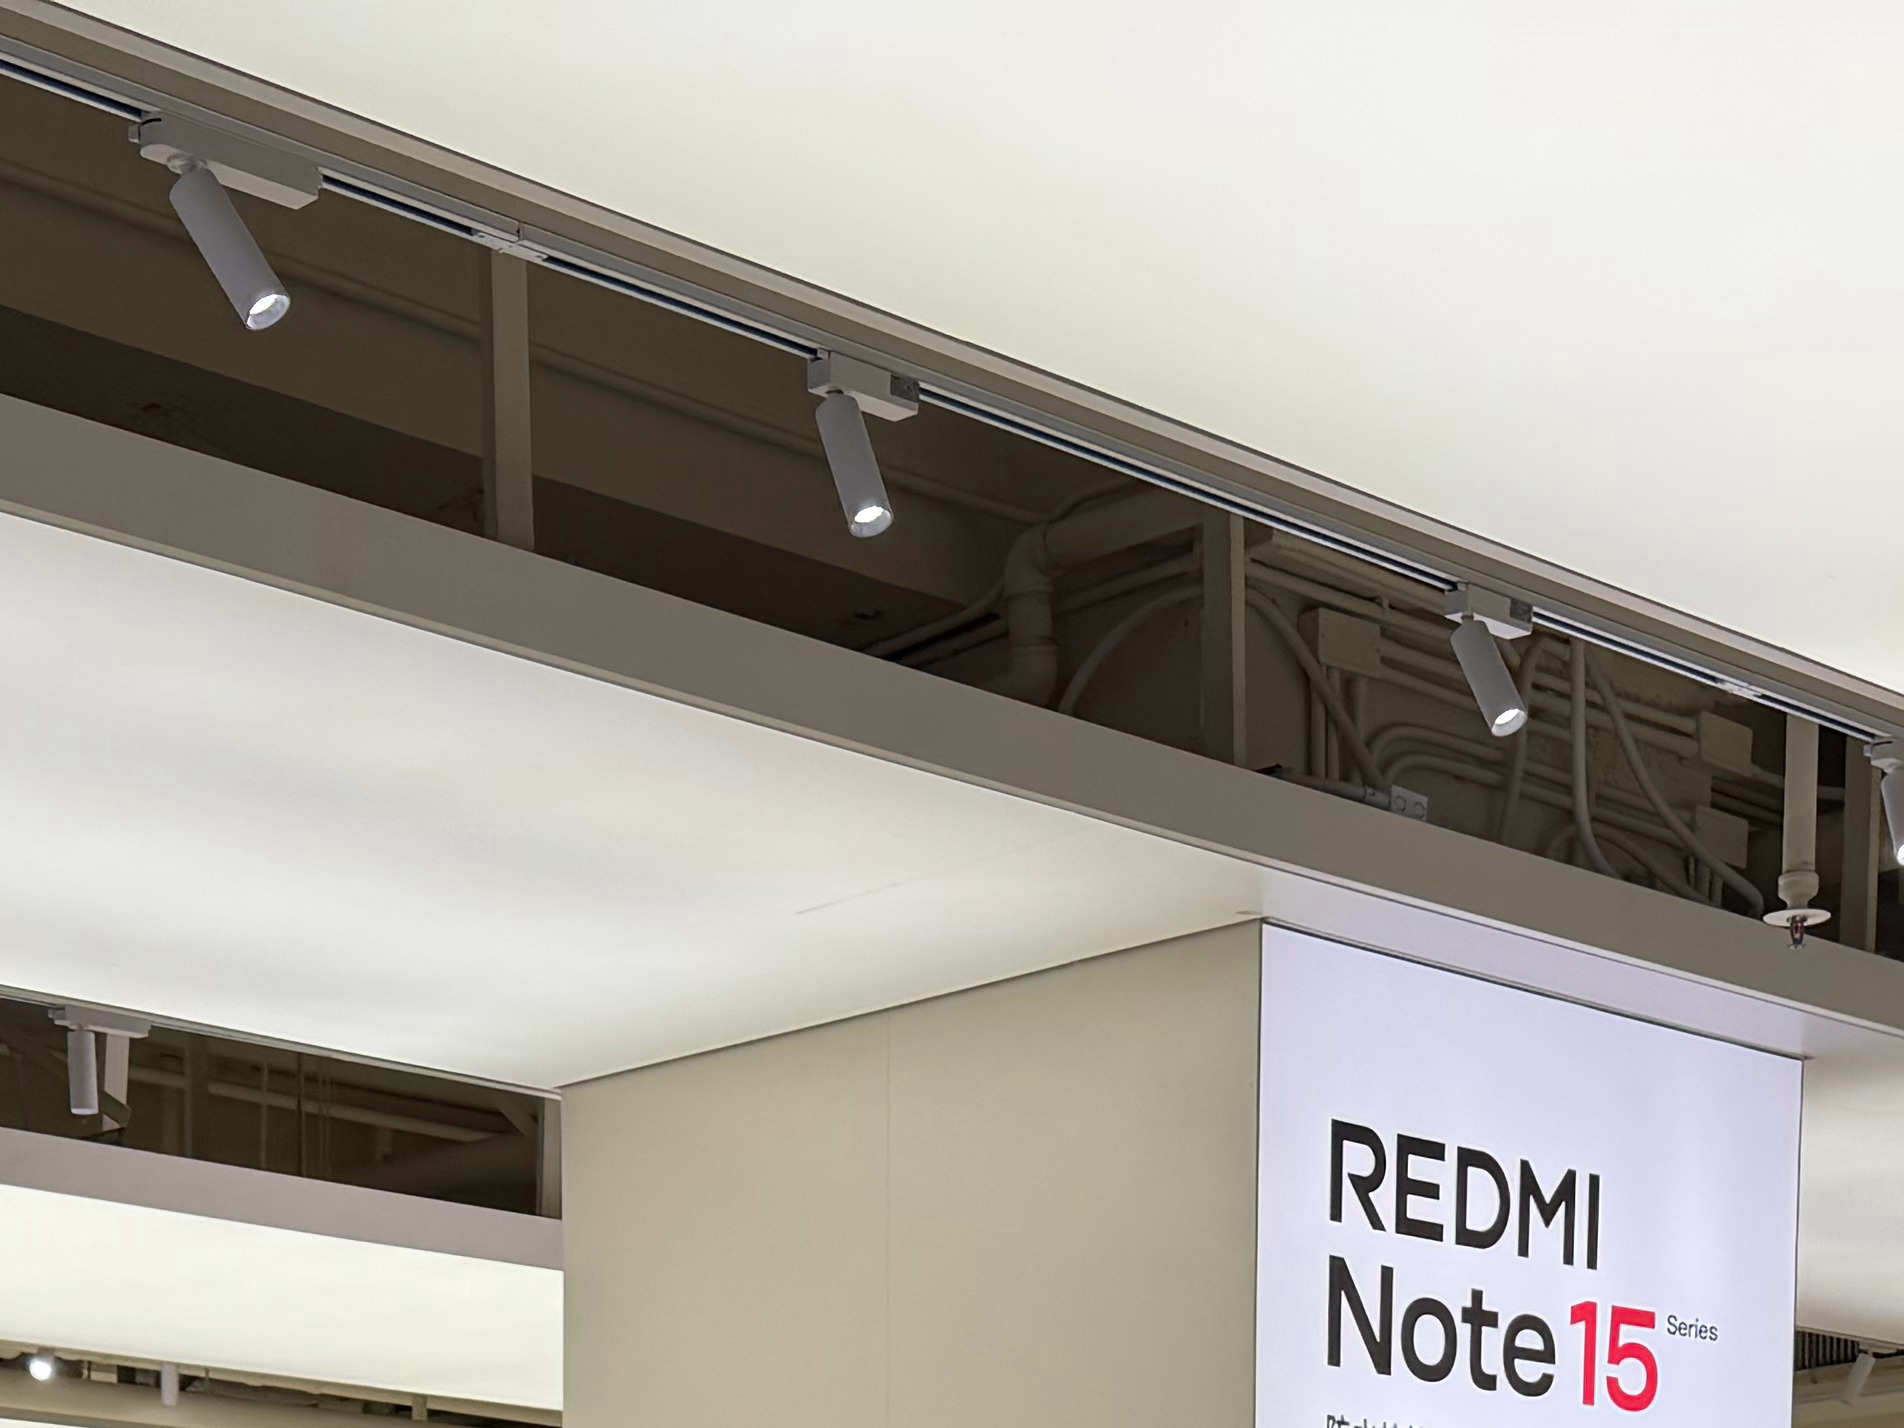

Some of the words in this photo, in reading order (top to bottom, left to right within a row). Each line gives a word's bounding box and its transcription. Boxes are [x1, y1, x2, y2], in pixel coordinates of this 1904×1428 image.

[1329, 1118, 1601, 1270] REDMI
[1327, 1255, 1556, 1399] Note
[1570, 1300, 1660, 1413] 15
[1666, 1314, 1719, 1342] Series
